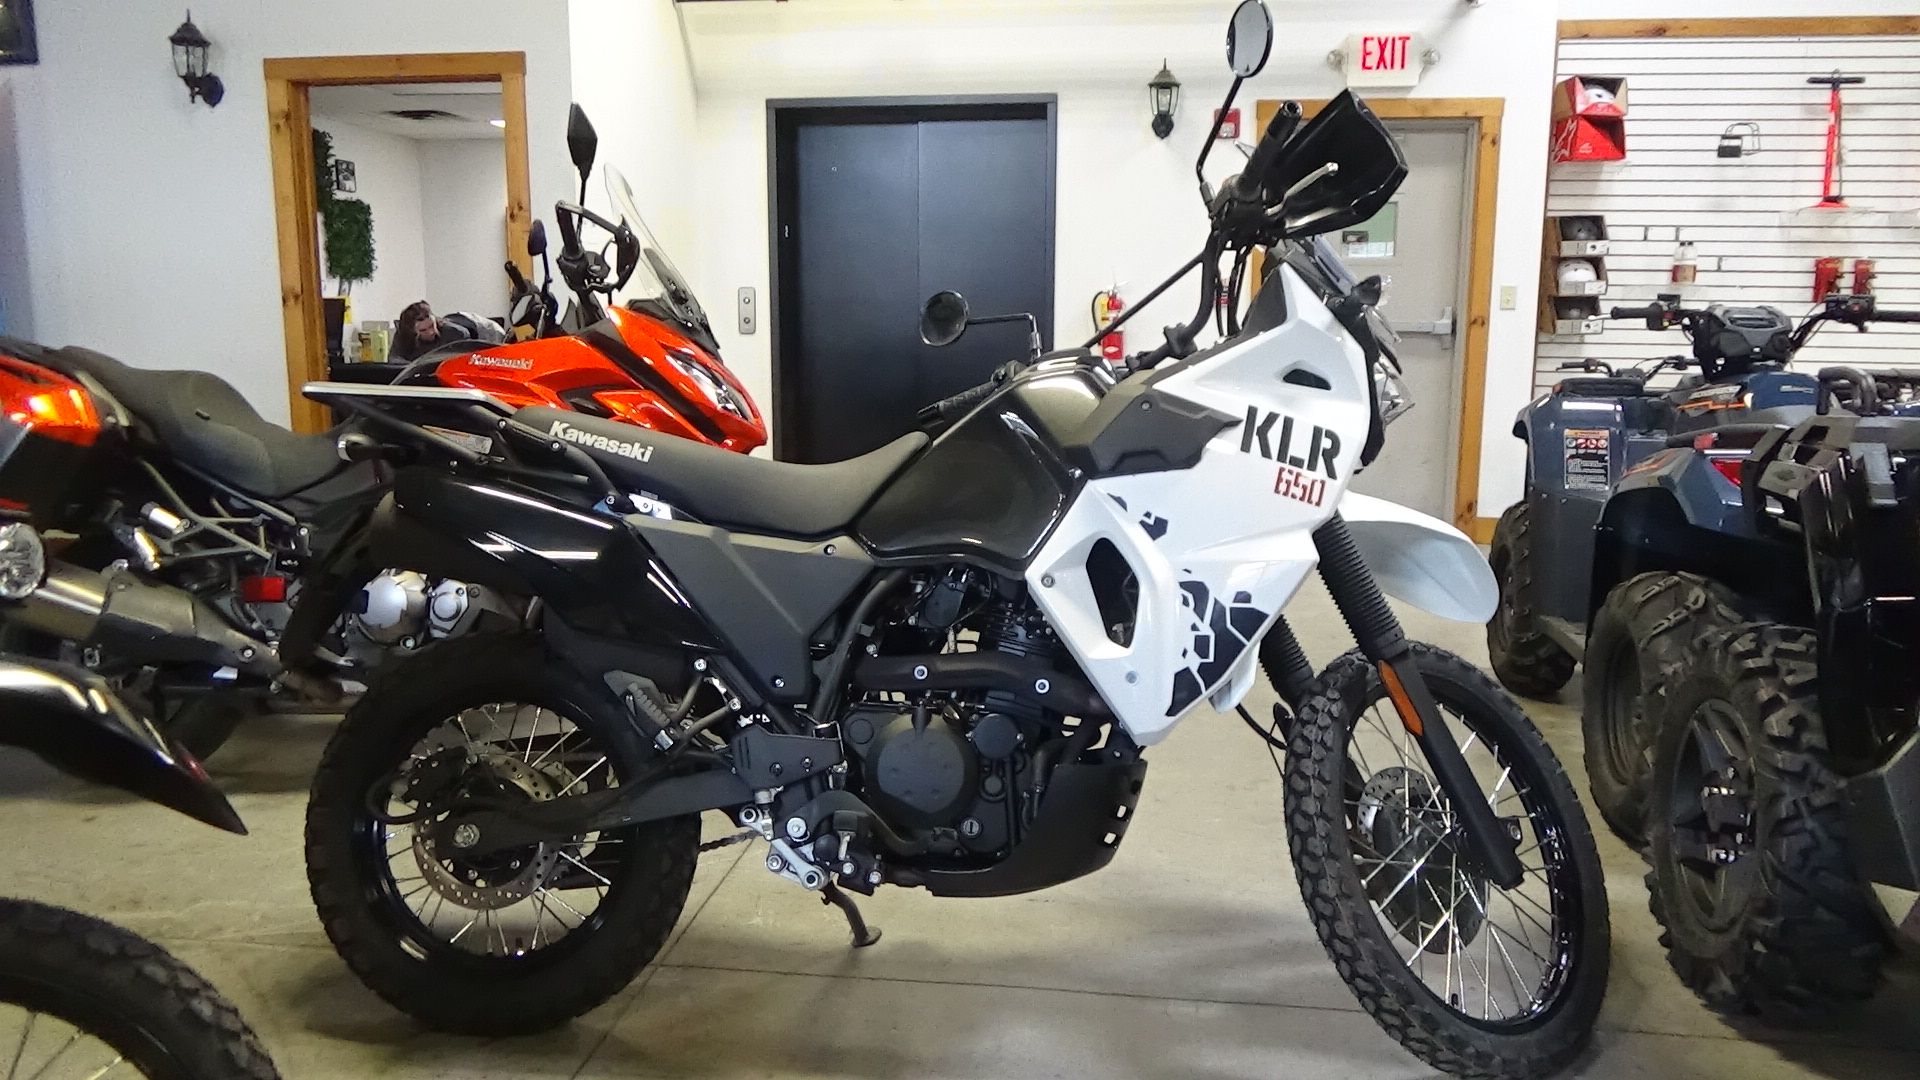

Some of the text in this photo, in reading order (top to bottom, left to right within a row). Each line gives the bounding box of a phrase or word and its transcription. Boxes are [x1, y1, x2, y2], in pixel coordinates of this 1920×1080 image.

[1362, 36, 1410, 70] EXIT
[549, 420, 654, 463] Kawasaki
[1240, 404, 1342, 481] KLR
[1274, 466, 1327, 508] 650
